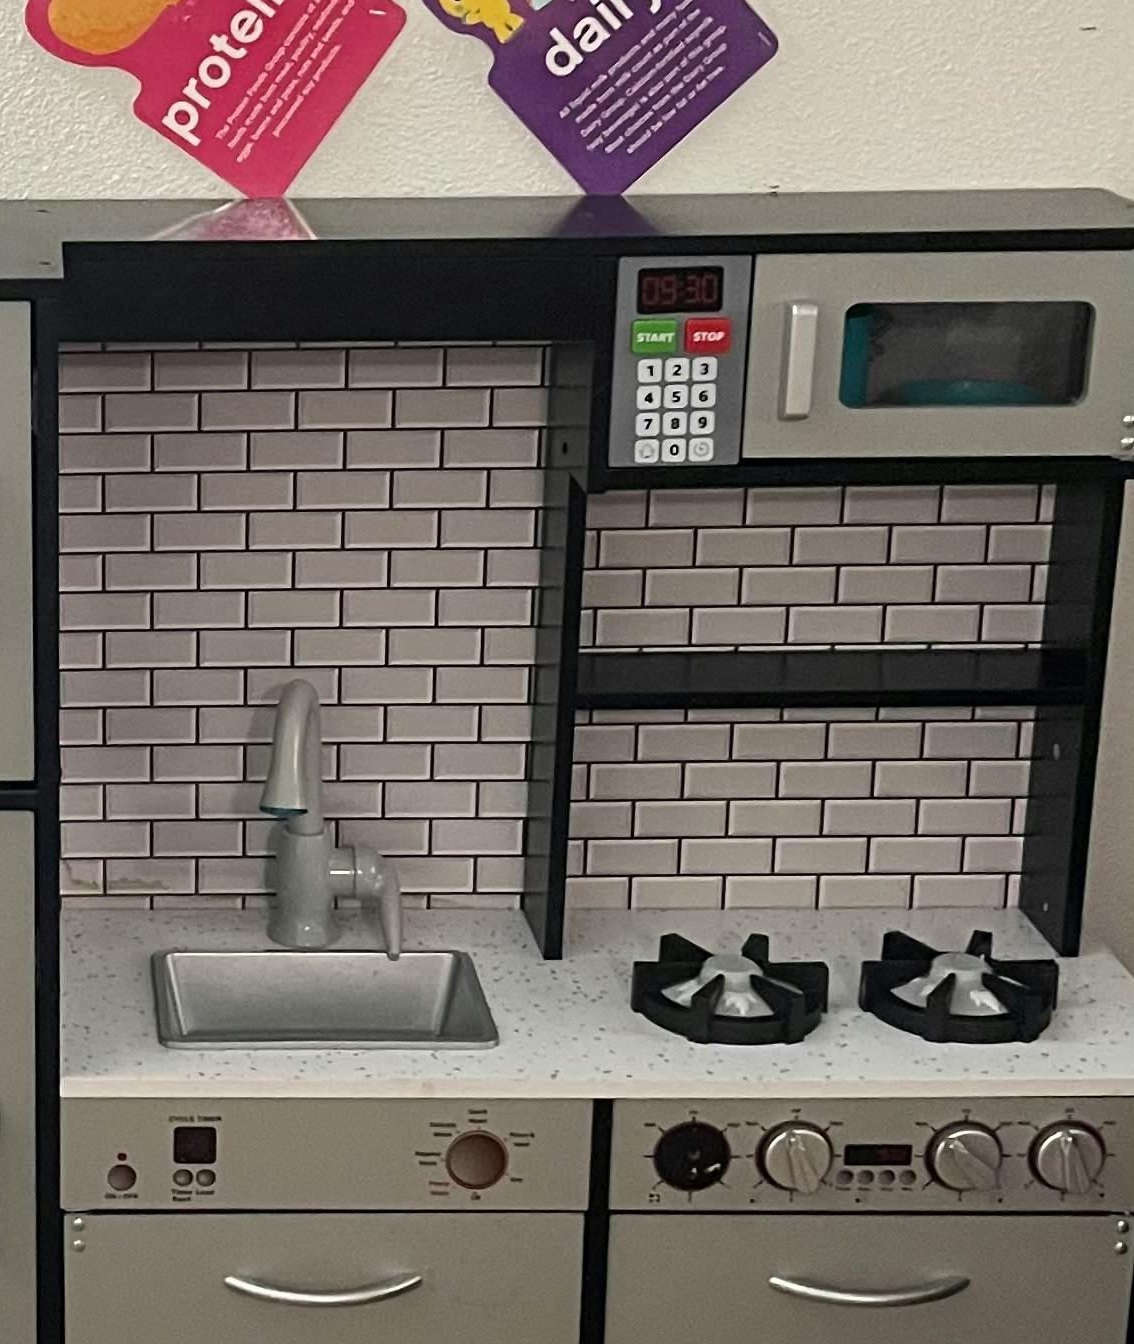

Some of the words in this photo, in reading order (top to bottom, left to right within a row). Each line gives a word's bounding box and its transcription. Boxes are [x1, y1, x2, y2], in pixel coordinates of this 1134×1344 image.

[636, 332, 675, 343] START
[692, 331, 725, 342] STOP
[646, 365, 654, 377] 1
[672, 364, 682, 376] 2
[700, 363, 709, 375] 3
[644, 392, 654, 403] 4
[672, 391, 681, 403] 5
[698, 390, 709, 402] 6
[643, 418, 653, 430] 7
[671, 417, 680, 430] 8
[698, 416, 707, 429] 9
[669, 444, 679, 456] 0
